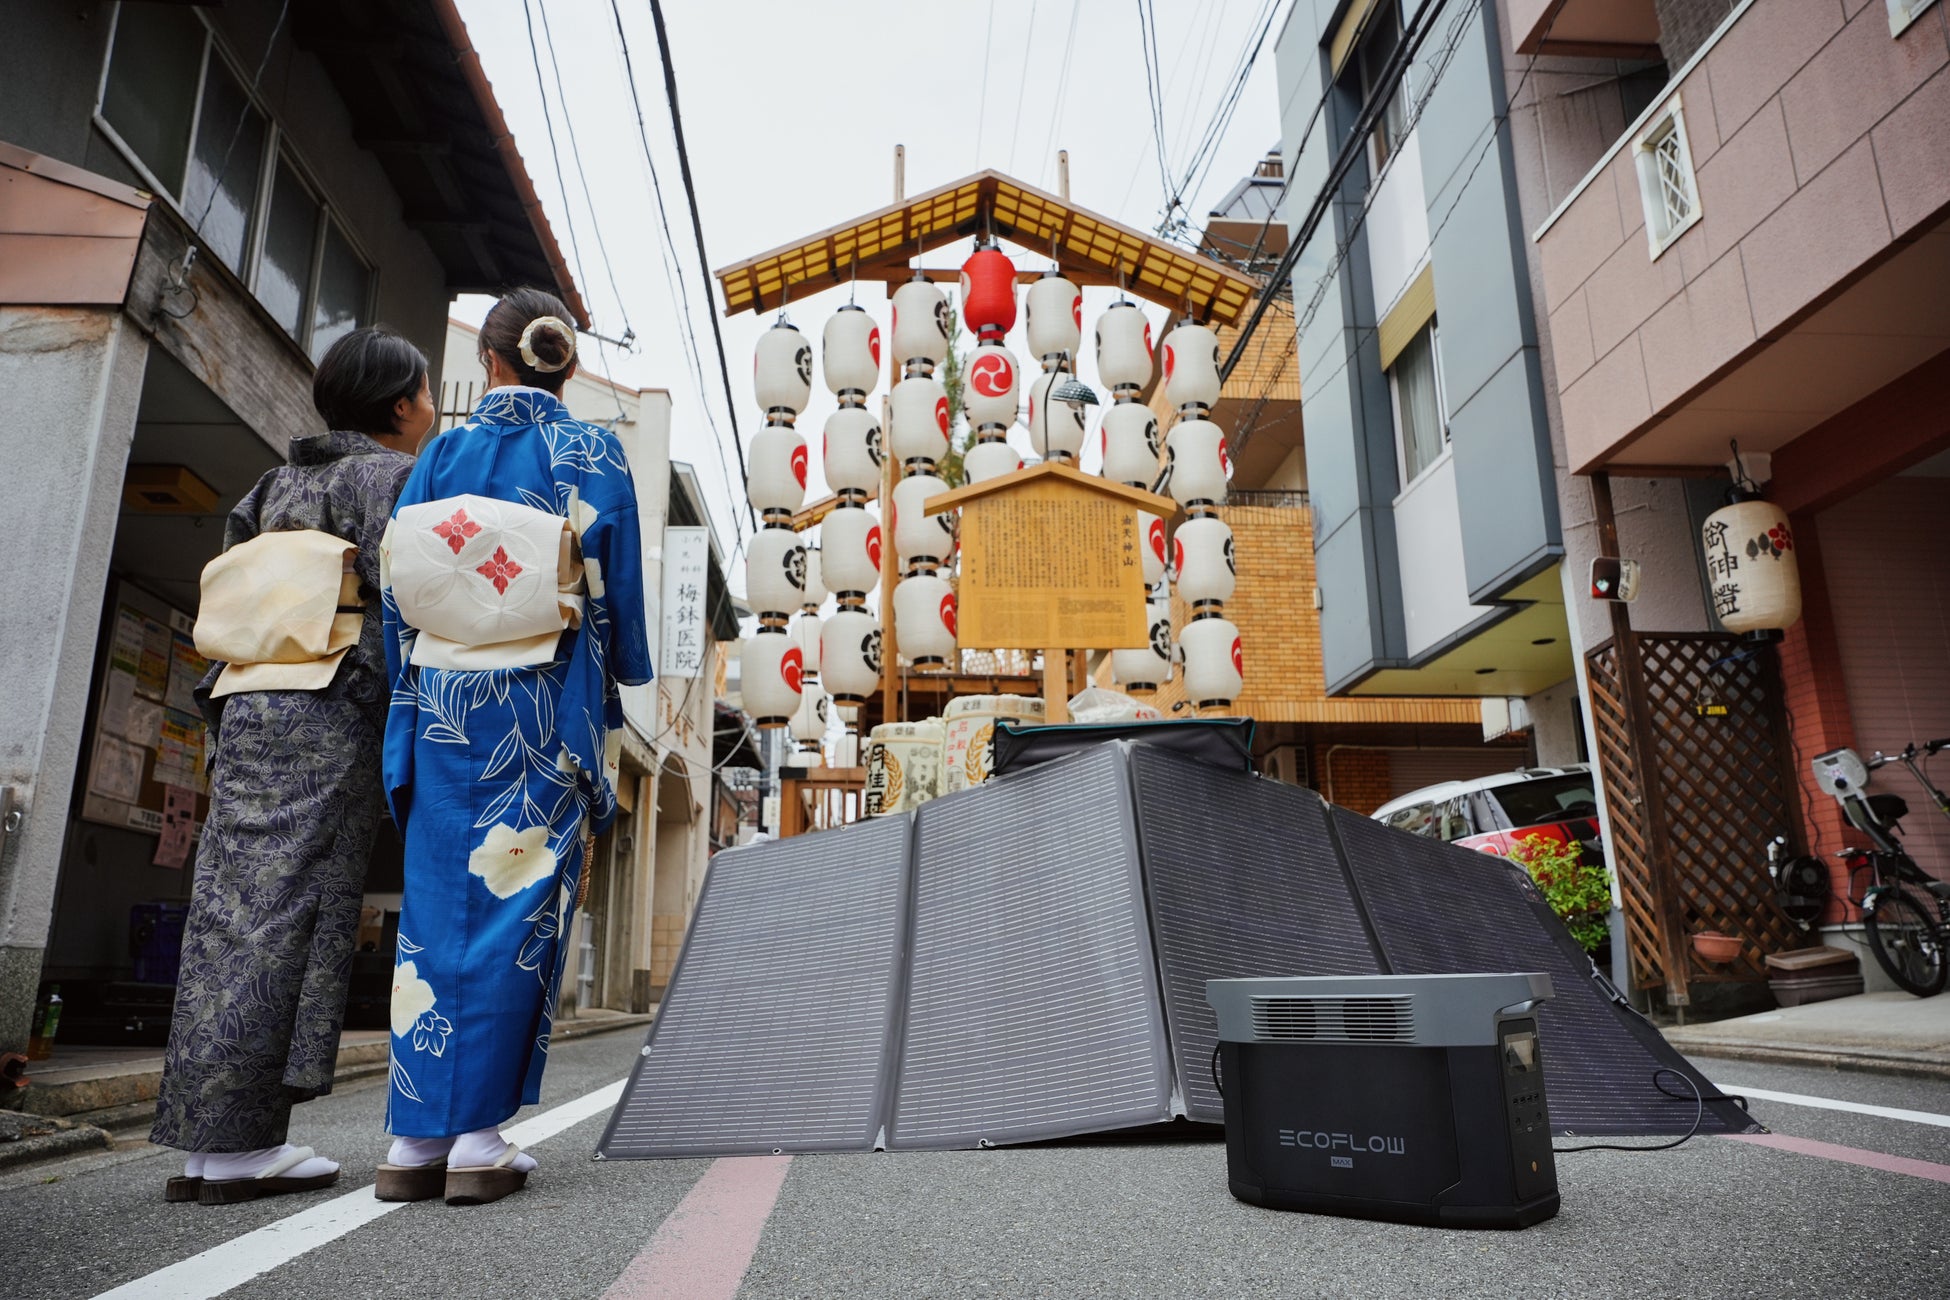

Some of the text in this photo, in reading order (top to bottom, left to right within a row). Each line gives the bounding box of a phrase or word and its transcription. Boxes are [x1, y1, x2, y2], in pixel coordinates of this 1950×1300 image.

[676, 583, 700, 669] 梅鉢医院
[1279, 1129, 1405, 1155] ECOFLOW
[1331, 1157, 1352, 1167] MAX
